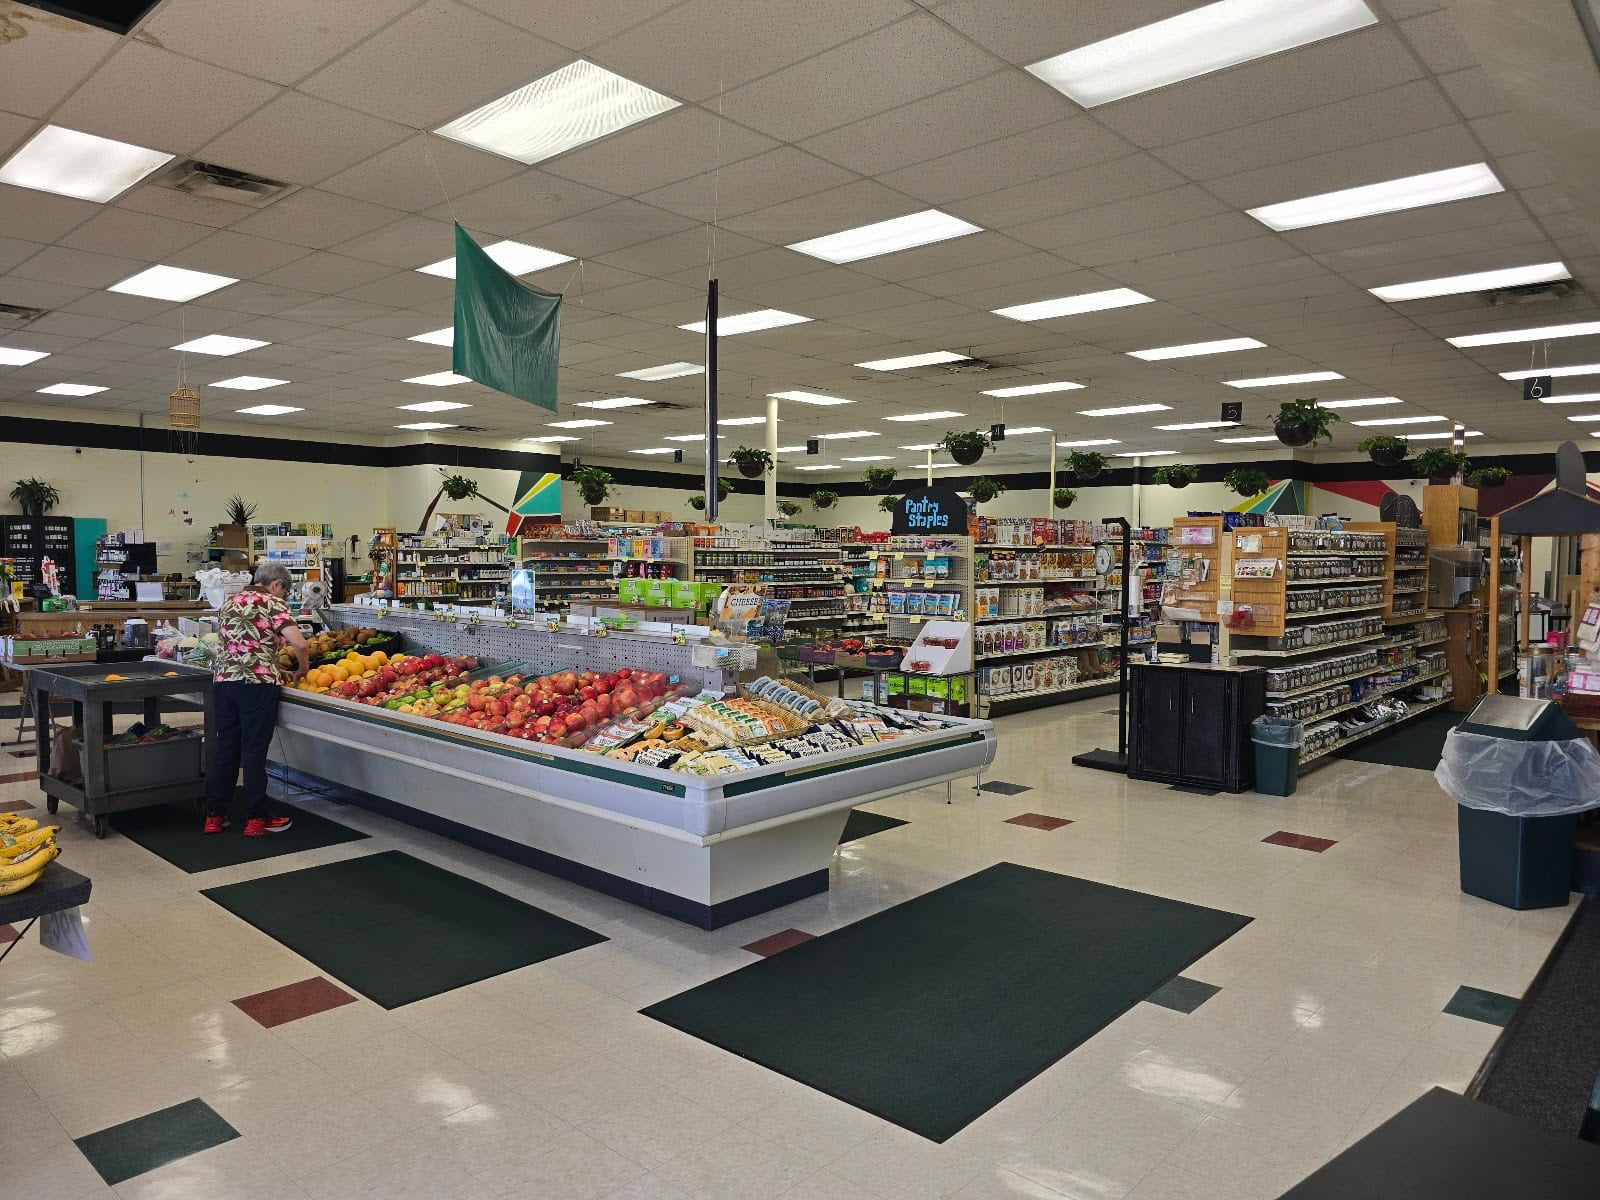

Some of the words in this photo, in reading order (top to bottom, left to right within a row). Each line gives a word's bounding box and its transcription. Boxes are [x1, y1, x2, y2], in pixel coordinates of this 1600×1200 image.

[1530, 378, 1543, 398] 6
[1228, 406, 1238, 419] 5
[905, 496, 939, 513] Pantry
[908, 512, 949, 528] Staples
[730, 597, 759, 607] CHEESE
